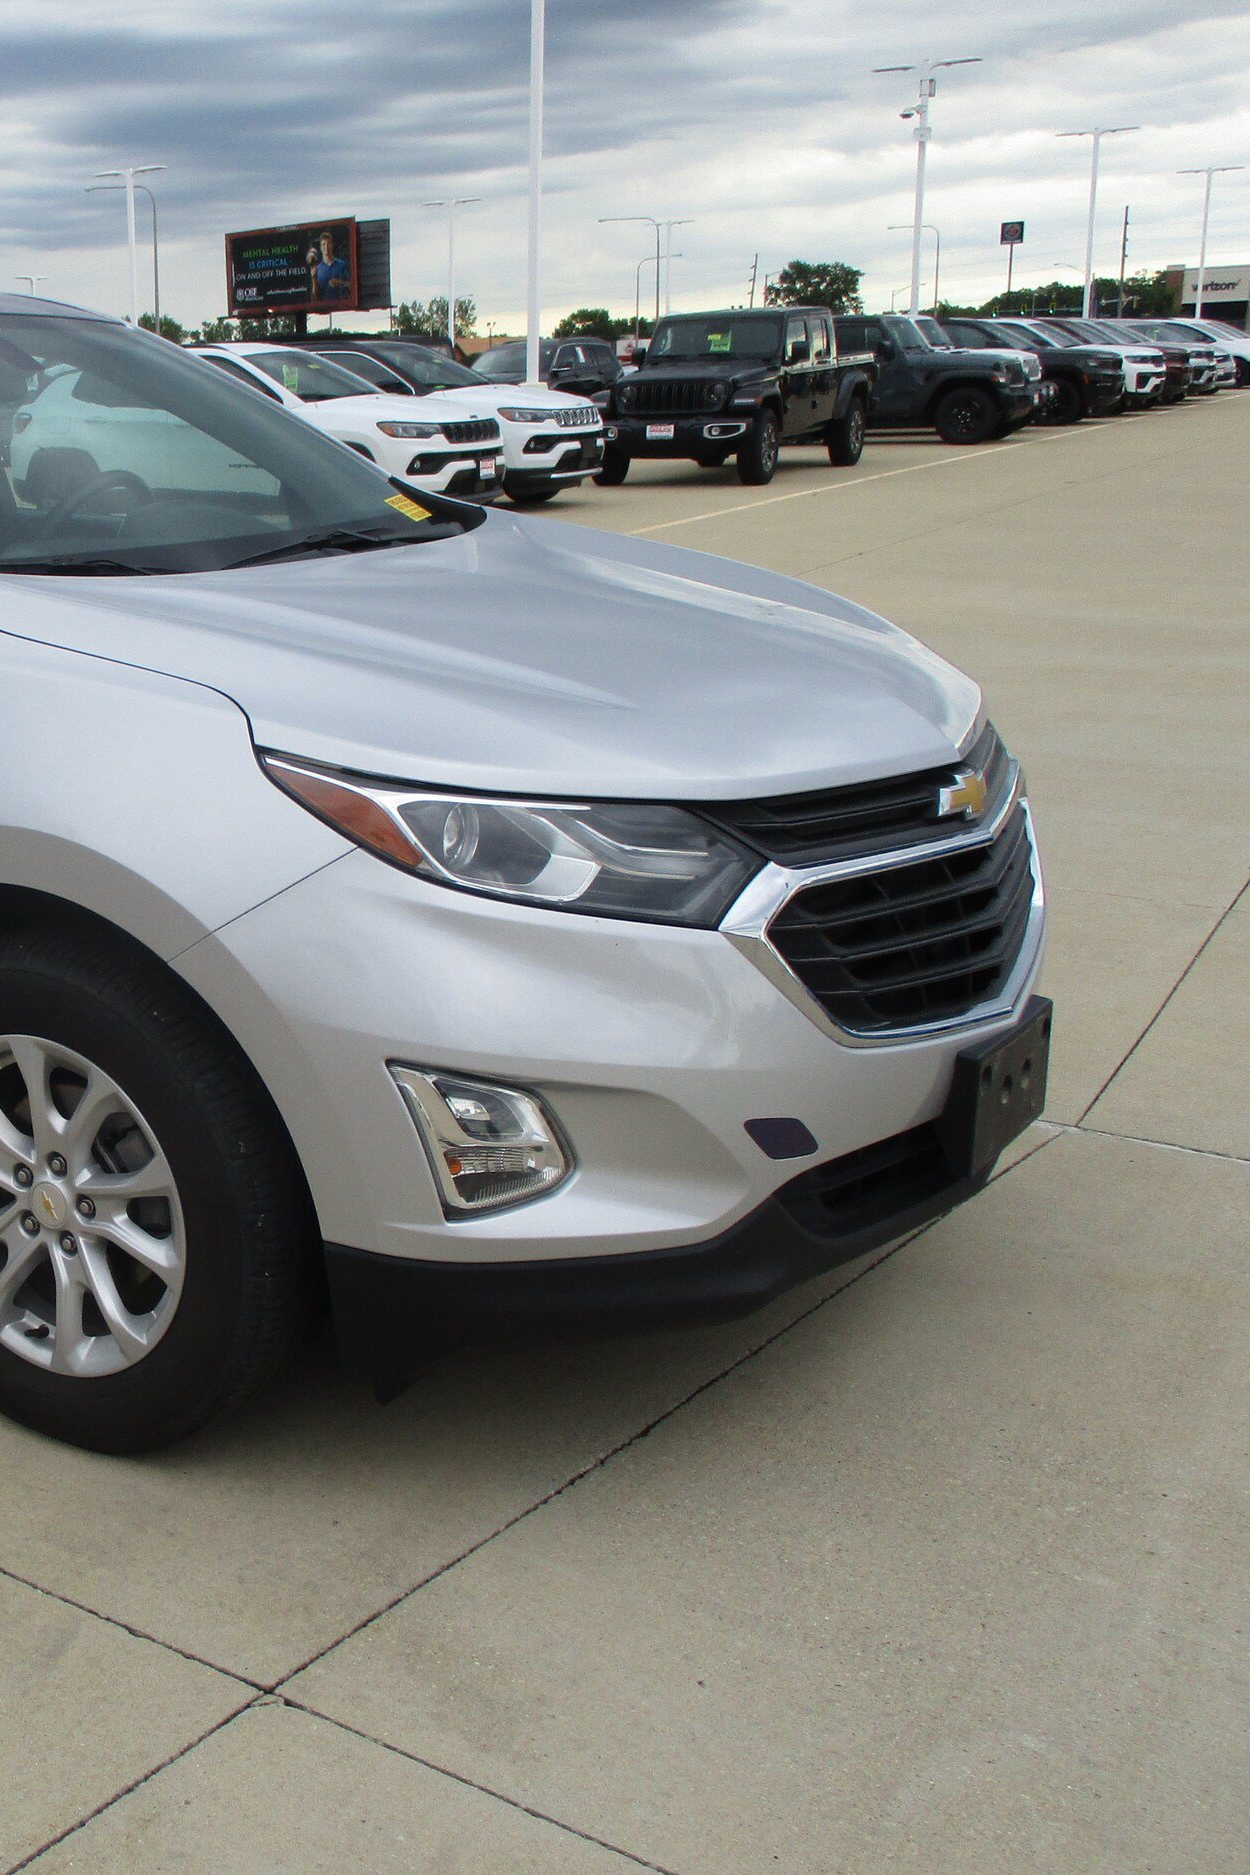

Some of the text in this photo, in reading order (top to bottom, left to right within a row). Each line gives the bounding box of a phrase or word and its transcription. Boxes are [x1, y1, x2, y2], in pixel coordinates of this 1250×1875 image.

[242, 245, 299, 258] MENTAL HEALTH
[248, 261, 256, 270] IS
[256, 258, 288, 268] CRITICAL
[235, 273, 246, 281] ON
[247, 271, 261, 280] AND
[262, 270, 274, 279] OFF
[275, 269, 287, 277] THE
